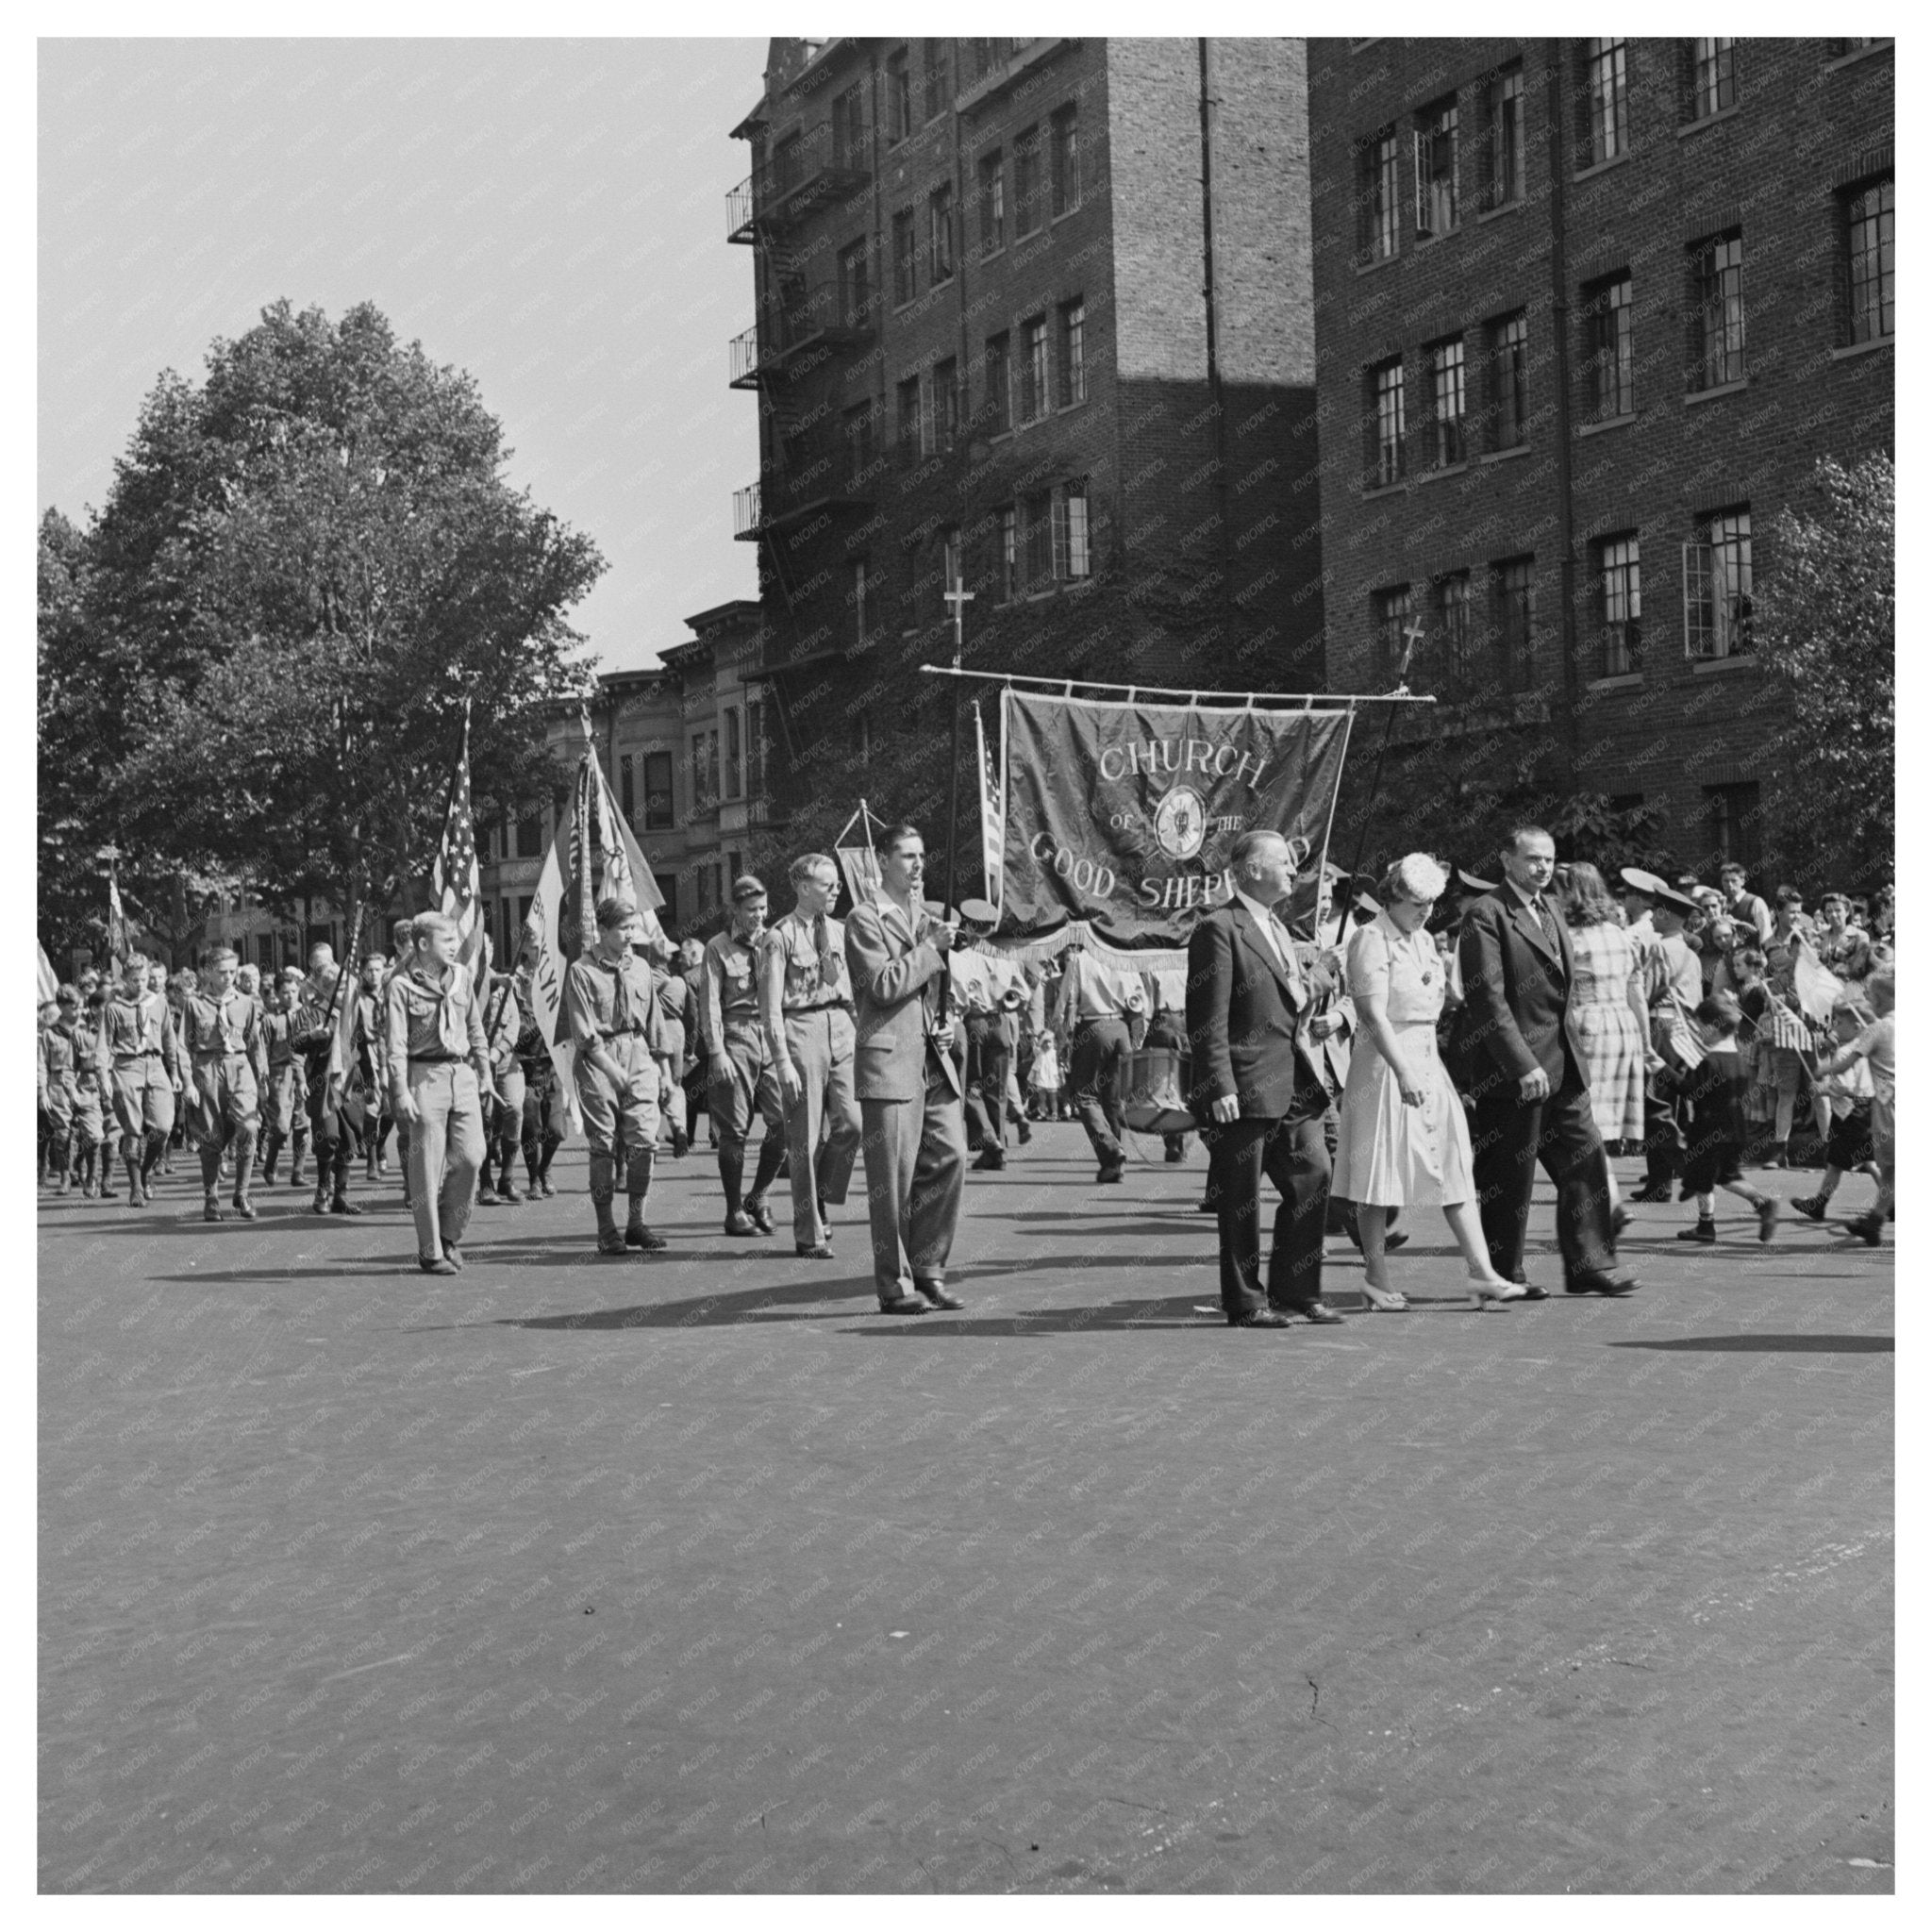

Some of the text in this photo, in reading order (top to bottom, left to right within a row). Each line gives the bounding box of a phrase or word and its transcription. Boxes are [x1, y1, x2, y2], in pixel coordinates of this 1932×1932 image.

[1100, 740, 1267, 789] CHURCH
[1110, 814, 1241, 832] OF THE
[1030, 831, 1115, 898] GOOD
[532, 891, 559, 1012] BRKLYN
